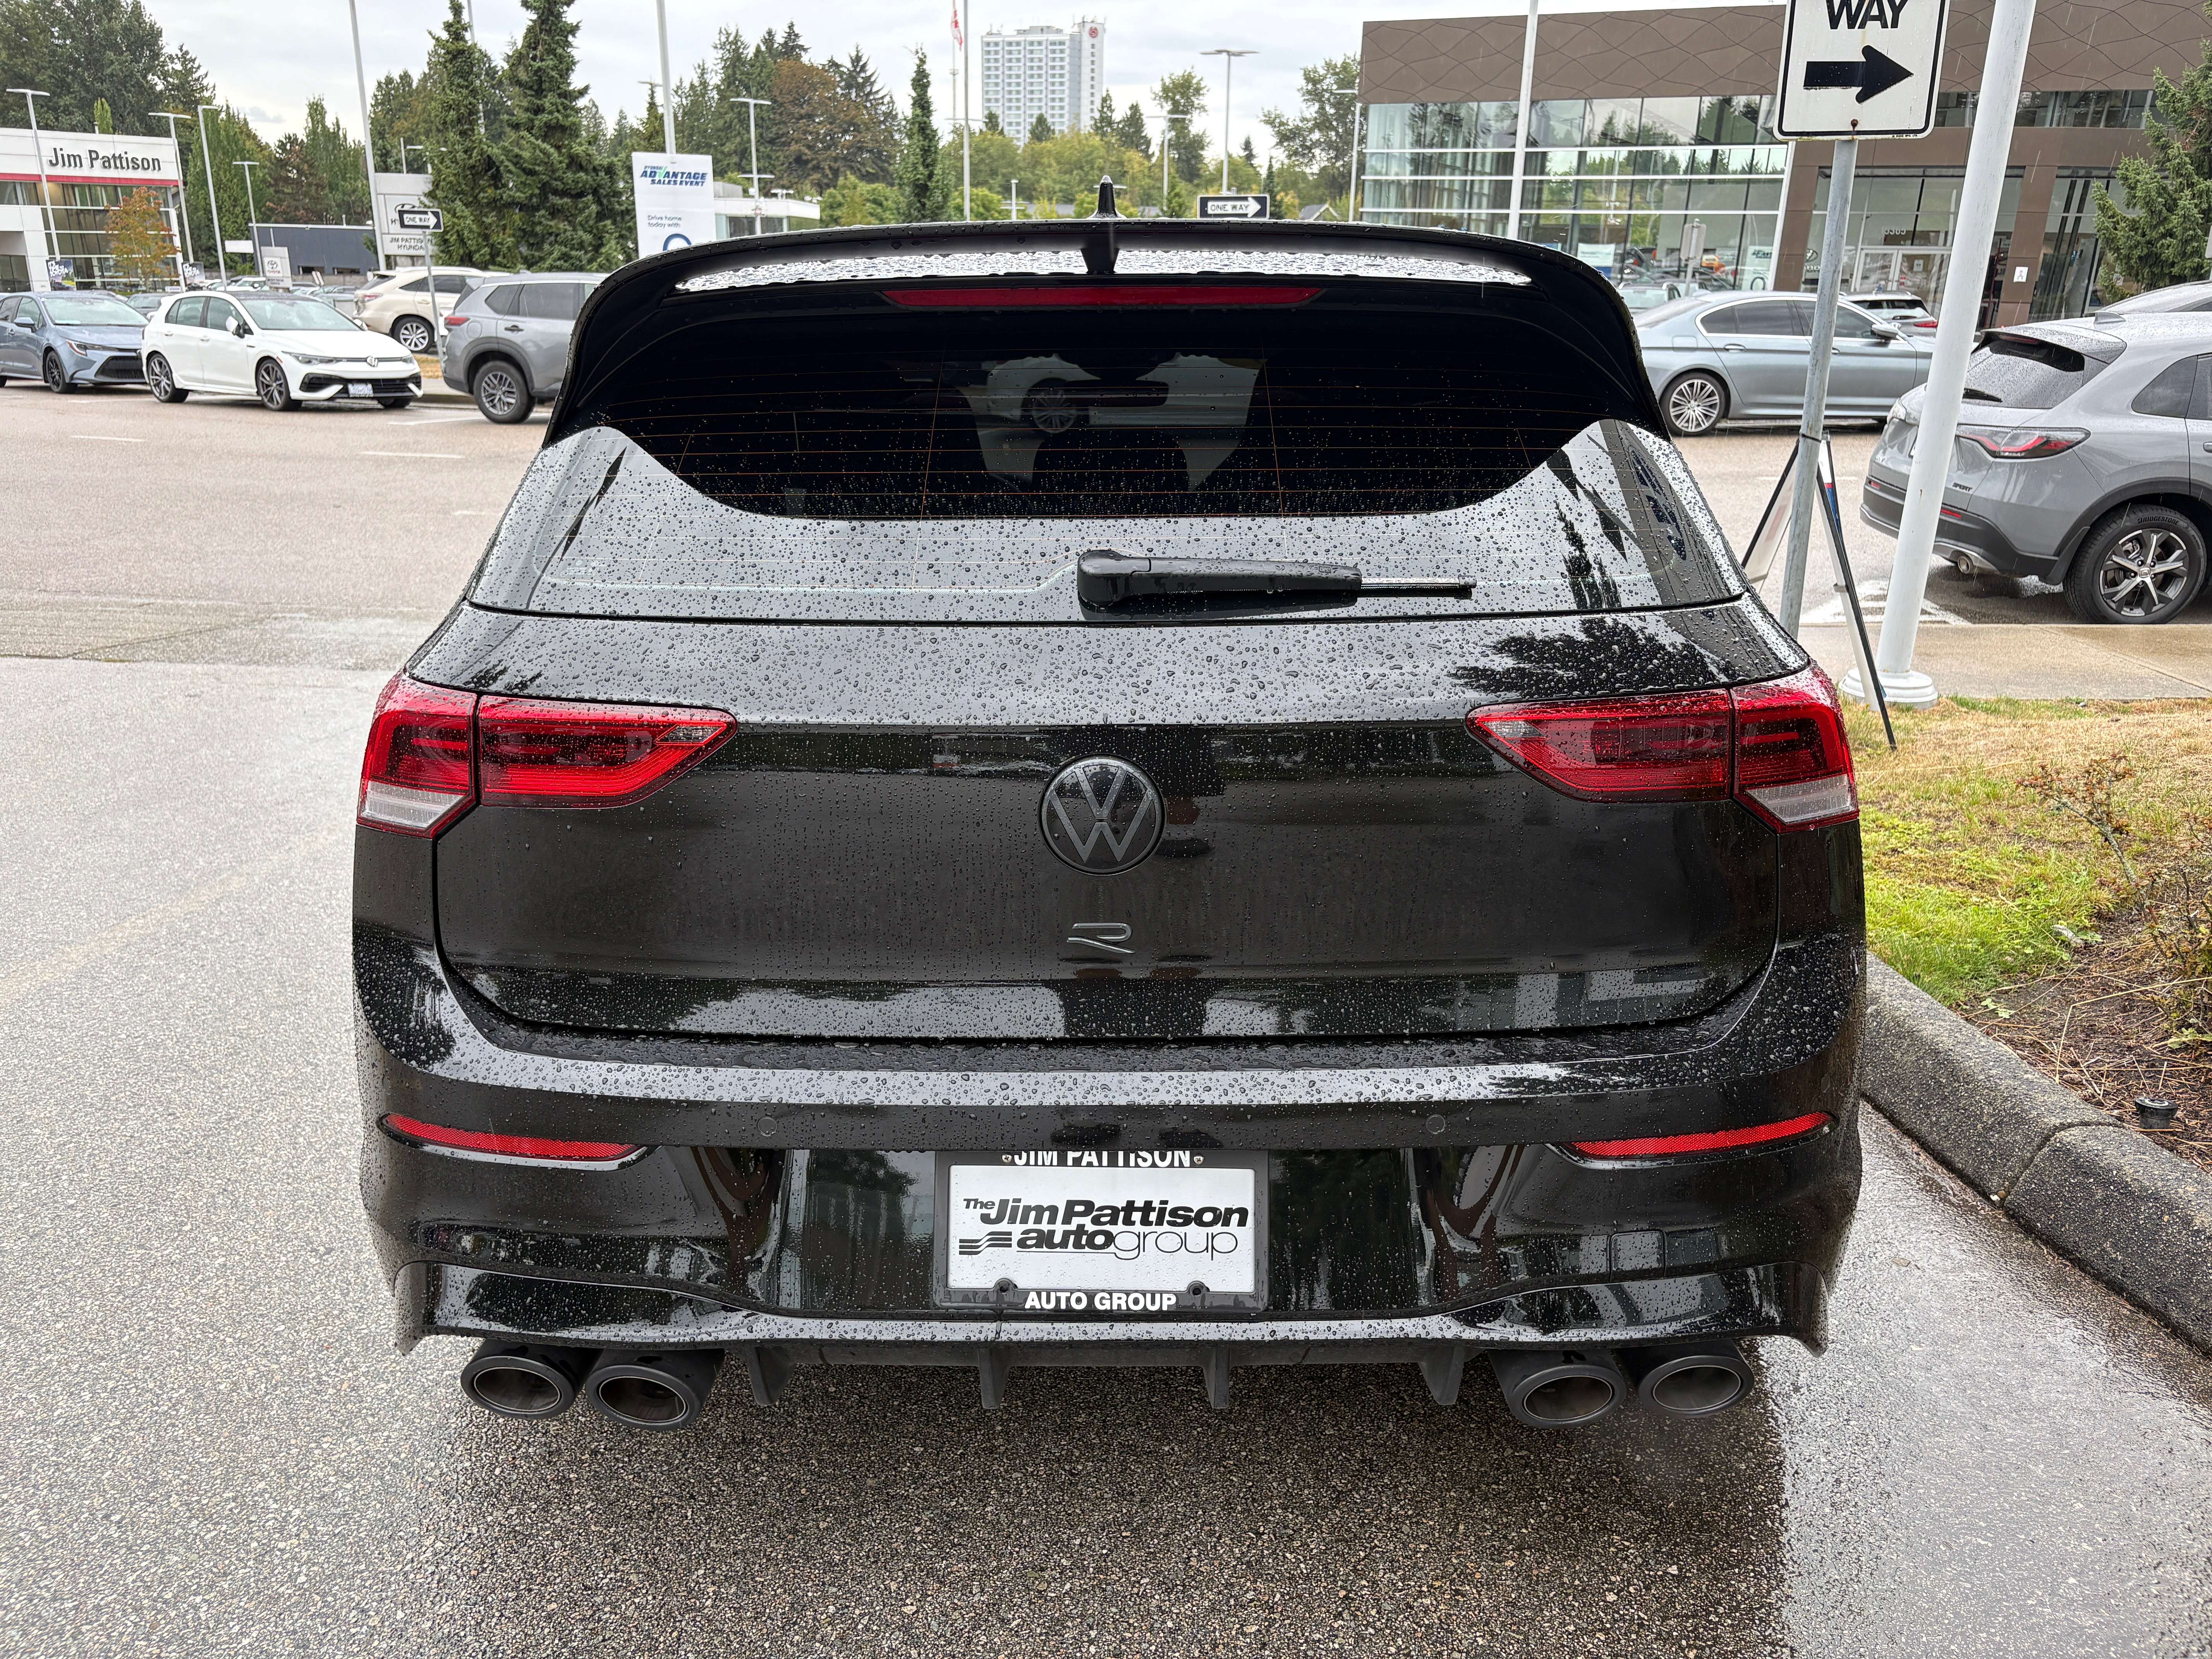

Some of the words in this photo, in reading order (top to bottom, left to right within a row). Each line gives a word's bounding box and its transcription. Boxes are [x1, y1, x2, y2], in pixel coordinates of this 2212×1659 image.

[1826, 0, 1908, 29] WAY
[49, 148, 83, 168] Jim
[88, 149, 161, 171] Pattison
[1952, 483, 1972, 492] SPORT
[2138, 515, 2180, 526] BRIDGESTONE
[1066, 922, 1135, 954] R
[1014, 1151, 1058, 1166] JIM
[1067, 1151, 1190, 1168] PATTISON
[963, 1198, 996, 1209] The
[980, 1198, 1059, 1225] Jim
[1061, 1199, 1249, 1227] Pattison
[1025, 1291, 1087, 1310] AUTO
[1094, 1292, 1177, 1311] GROUP
